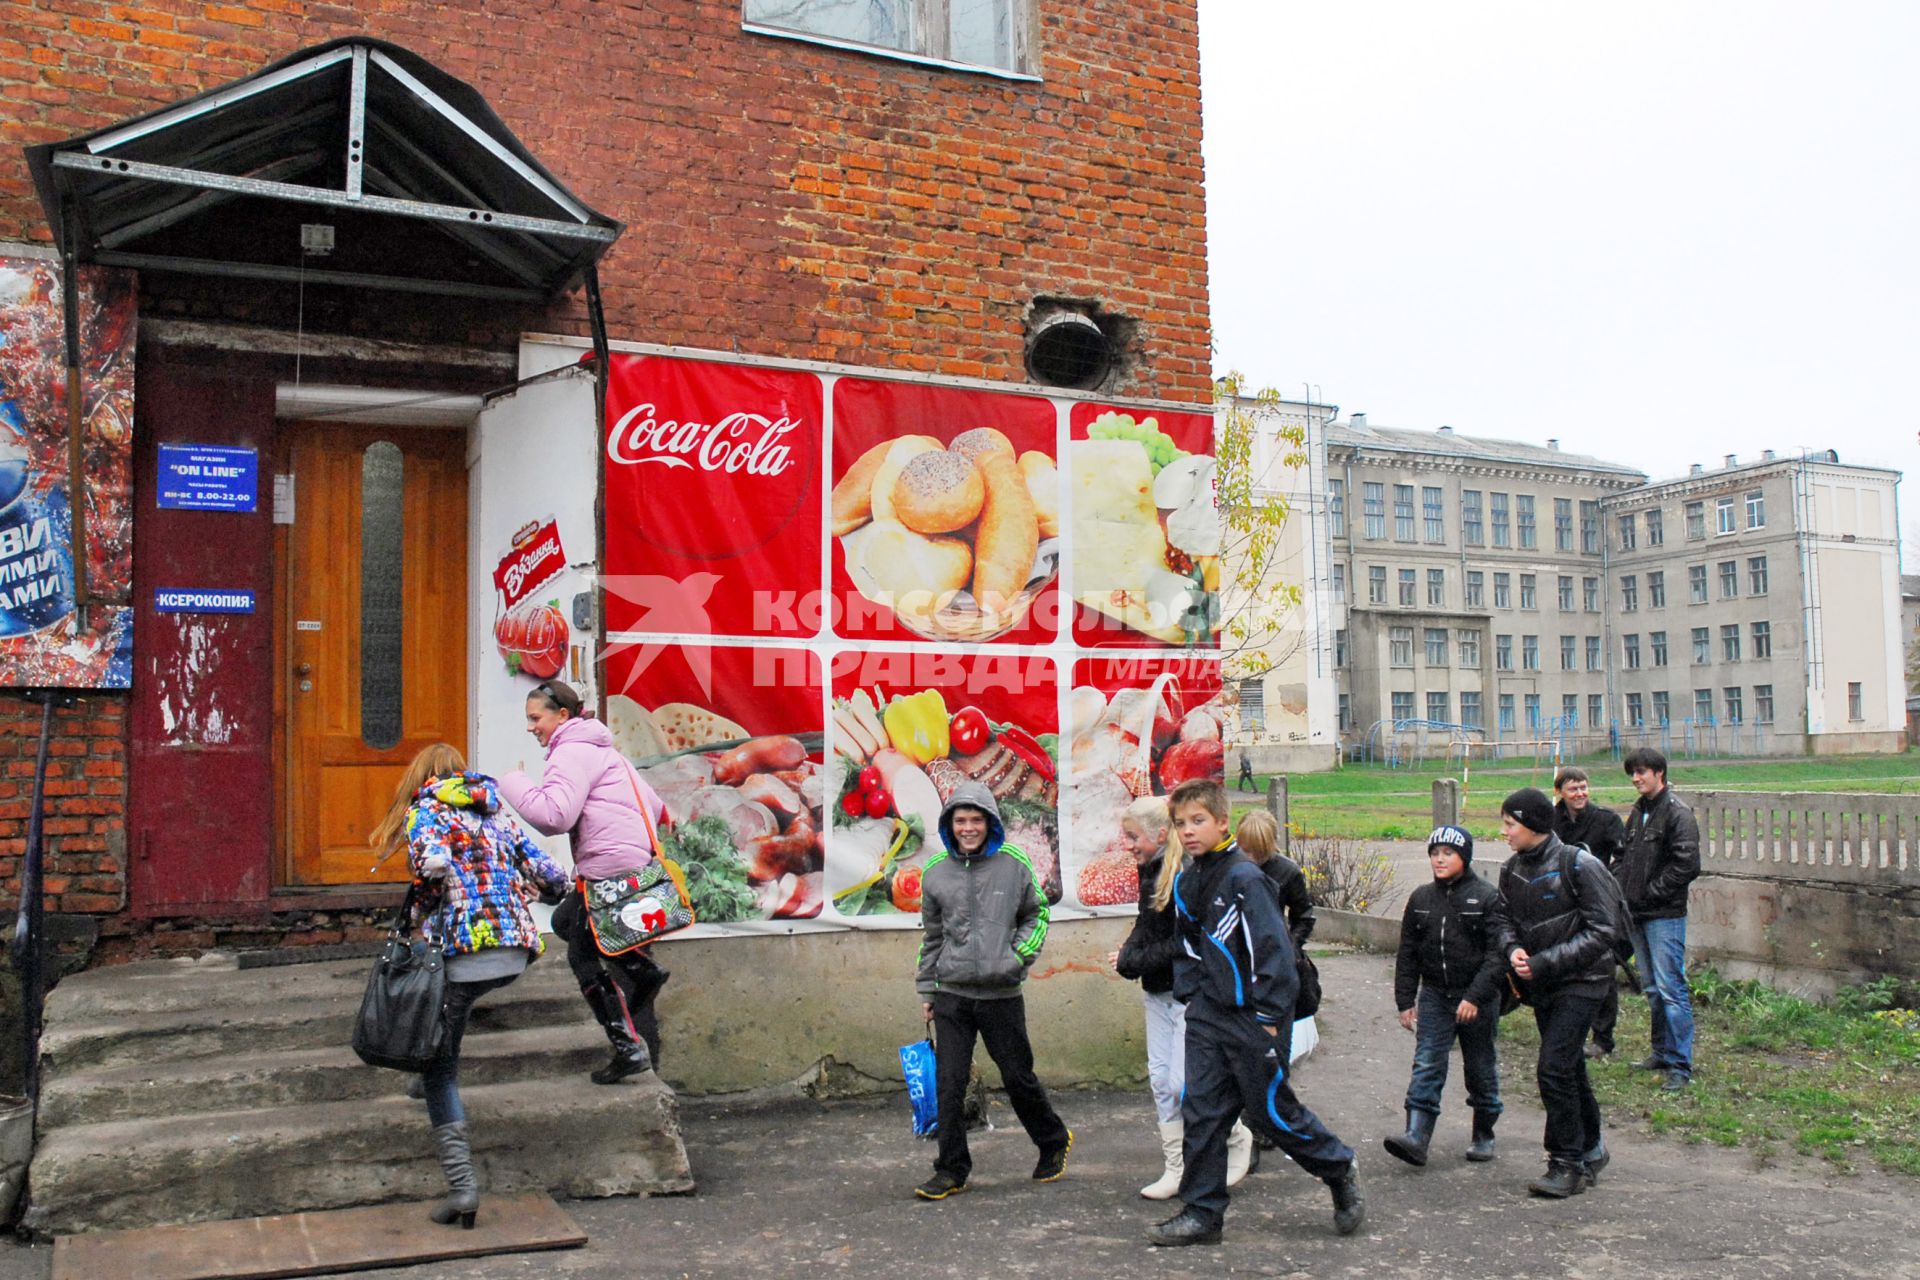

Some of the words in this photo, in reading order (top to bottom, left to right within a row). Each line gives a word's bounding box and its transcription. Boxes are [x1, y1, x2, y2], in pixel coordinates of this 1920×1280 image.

[607, 403, 802, 476] Coca-Cola
[197, 492, 250, 501] 8.00-22.00
[159, 593, 250, 608] КСЕРОКОПИЯ
